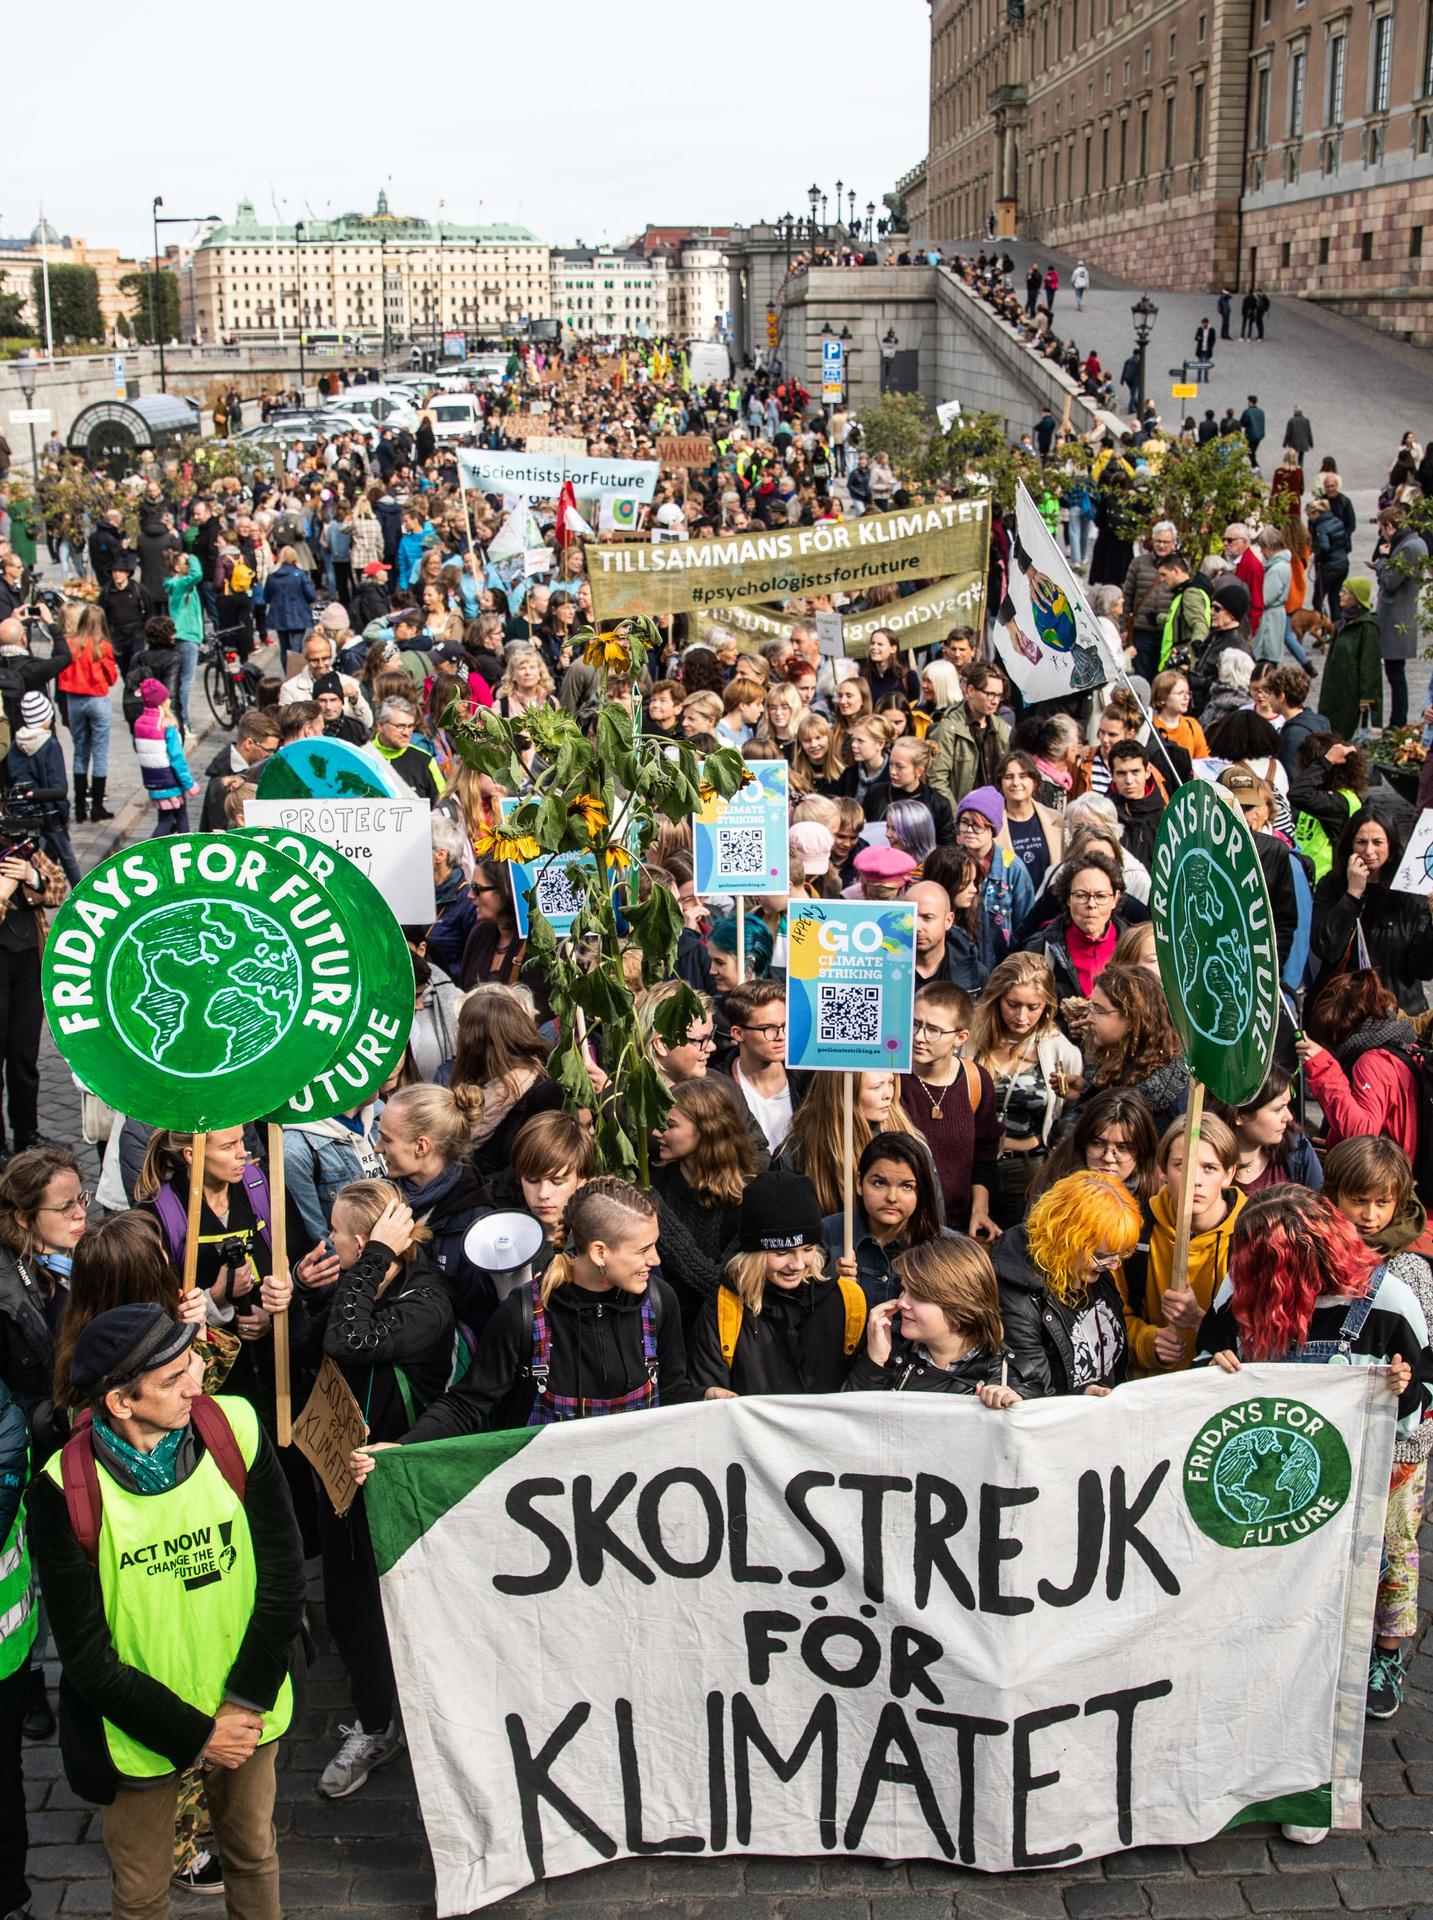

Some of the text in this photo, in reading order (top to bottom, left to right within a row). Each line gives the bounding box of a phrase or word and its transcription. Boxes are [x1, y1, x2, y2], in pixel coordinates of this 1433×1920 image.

[827, 343, 839, 359] P
[471, 463, 645, 488] #ScientistsForFuture
[600, 500, 989, 573] TILLSAMMANS FÖR KLIMATET
[691, 554, 921, 605] #psychologistsforfuture
[280, 806, 412, 833] PROTECT
[716, 804, 765, 815] CLIMATE
[716, 815, 765, 825] STRIKING
[51, 842, 353, 1038] FRIDAYS FOR FUTURE
[817, 920, 884, 954] GO
[1156, 791, 1198, 943] FRIDAYS
[1202, 795, 1243, 870] FOR
[1241, 866, 1273, 1065] FUTURE
[817, 955, 884, 968] CLIMATE
[817, 968, 884, 980] STRIKING
[288, 1007, 402, 1114] UTURE
[760, 1233, 803, 1250] VEGAN
[297, 1407, 353, 1502] KLIMATET
[4, 1473, 19, 1487] HH
[1188, 1402, 1340, 1545] FRIDAYS FOR FUTURE
[119, 1526, 211, 1570] ACT NOW
[492, 1459, 1181, 1617] SKOLSTREJK
[146, 1547, 215, 1577] CHANGE THE
[174, 1560, 216, 1579] FUTURE
[744, 1594, 945, 1705] FÖR
[505, 1678, 1174, 1880] KLIMATET
